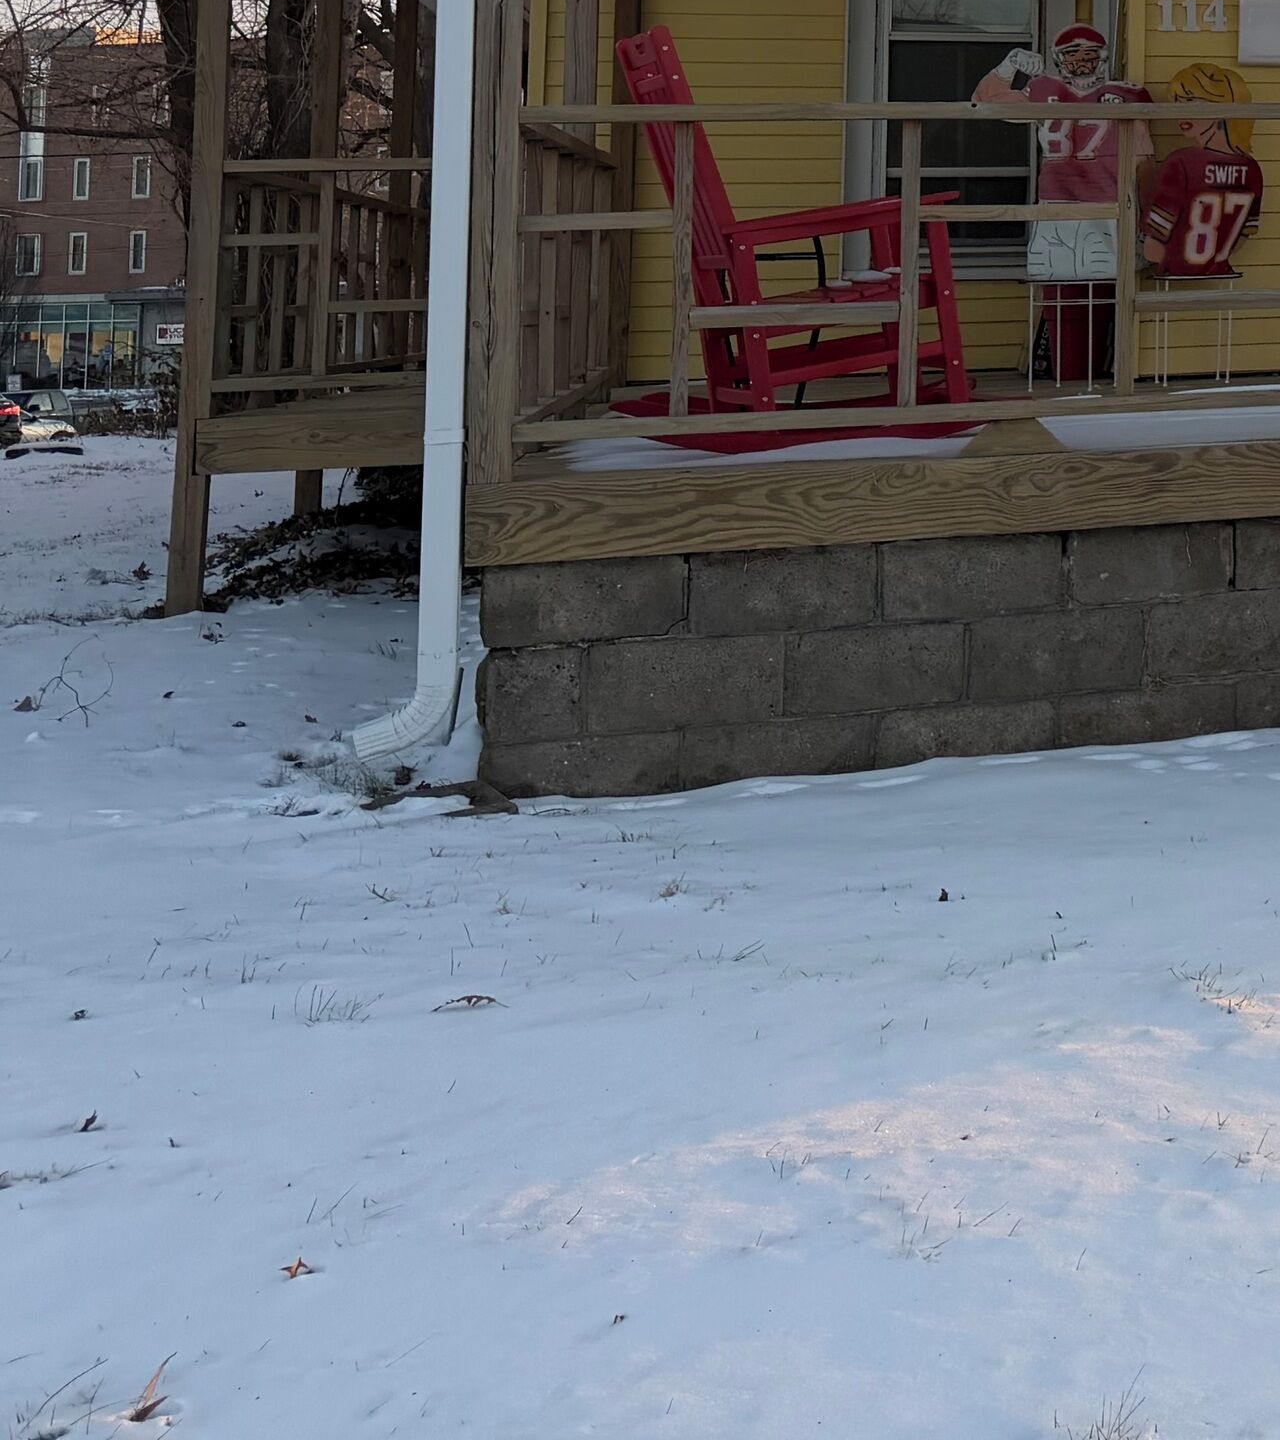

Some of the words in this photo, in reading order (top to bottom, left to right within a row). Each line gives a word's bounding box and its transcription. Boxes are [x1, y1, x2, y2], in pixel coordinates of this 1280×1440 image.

[1037, 118, 1110, 161] 87
[1204, 165, 1249, 186] SWIFT
[1183, 191, 1256, 266] 87
